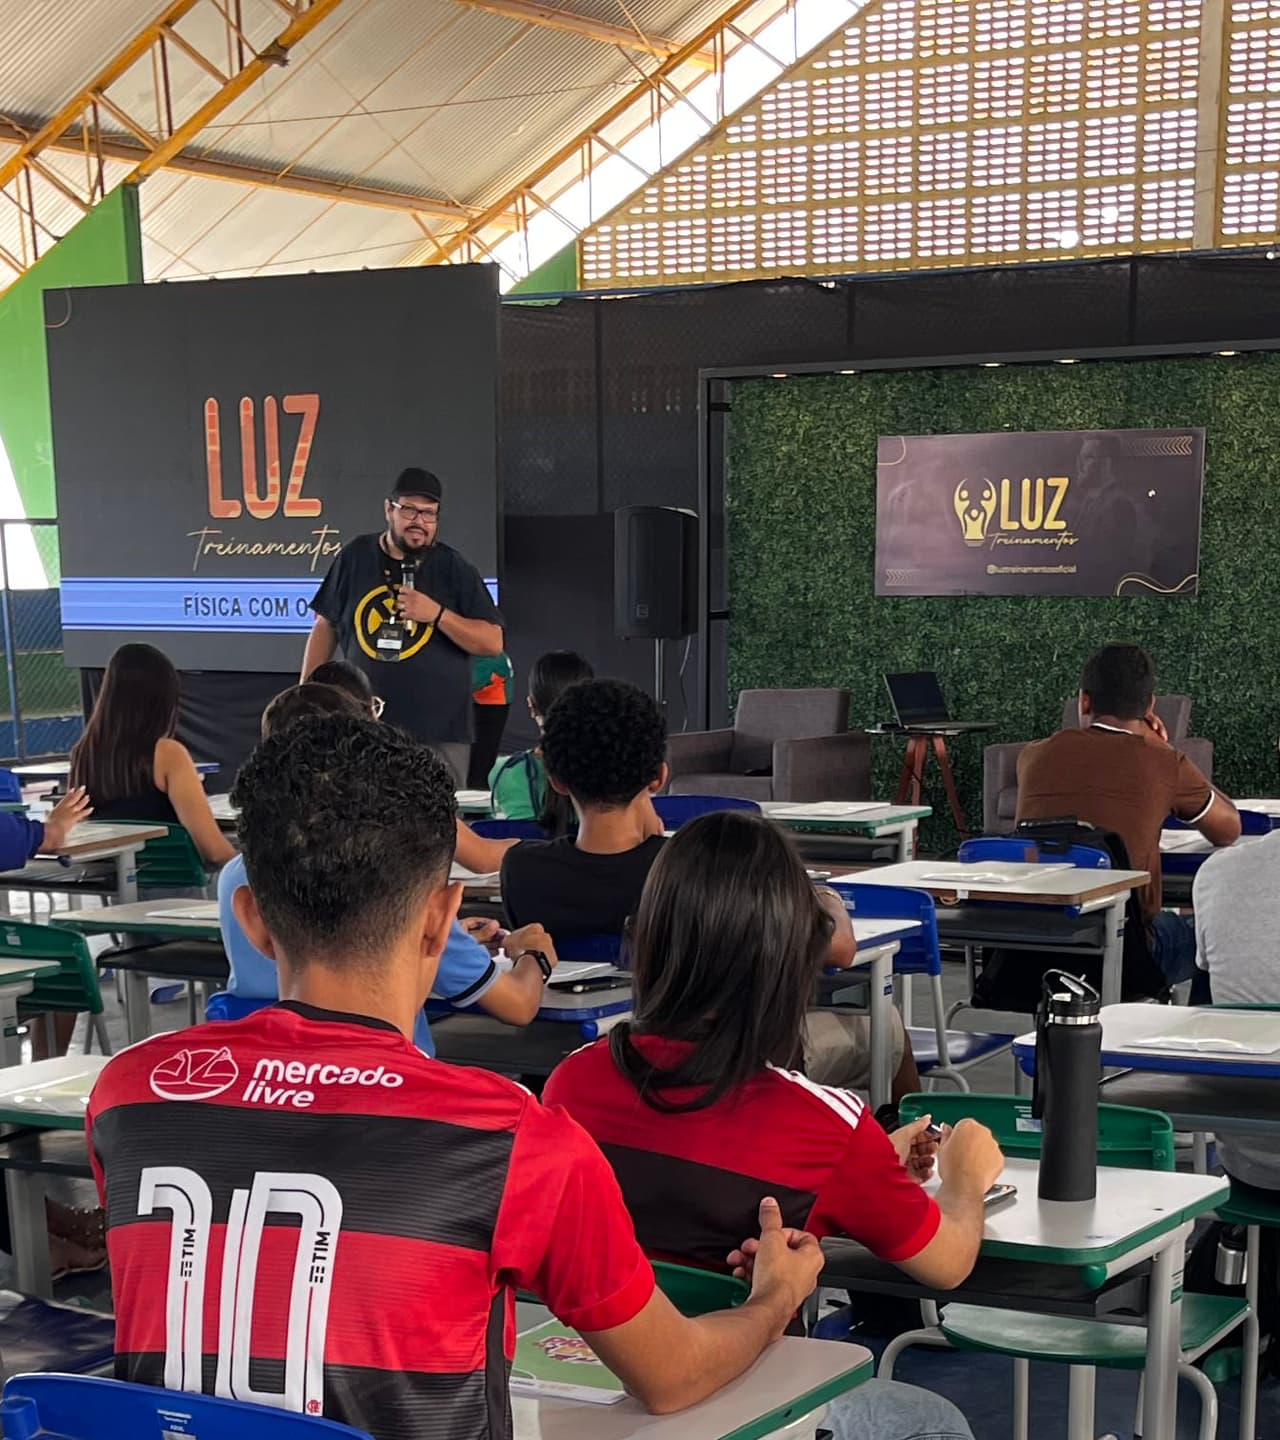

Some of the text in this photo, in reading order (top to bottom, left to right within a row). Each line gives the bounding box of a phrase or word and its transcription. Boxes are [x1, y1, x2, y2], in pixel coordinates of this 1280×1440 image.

[203, 393, 322, 520] LUZ
[999, 476, 1070, 531] LUZ
[987, 531, 1080, 551] Treinamentos
[183, 592, 308, 618] FÍSICA COM O
[252, 1057, 404, 1088] mercado
[241, 1079, 316, 1108] livre
[182, 1228, 197, 1259] TIM
[312, 1231, 331, 1263] TIM
[137, 1166, 343, 1417] 10
